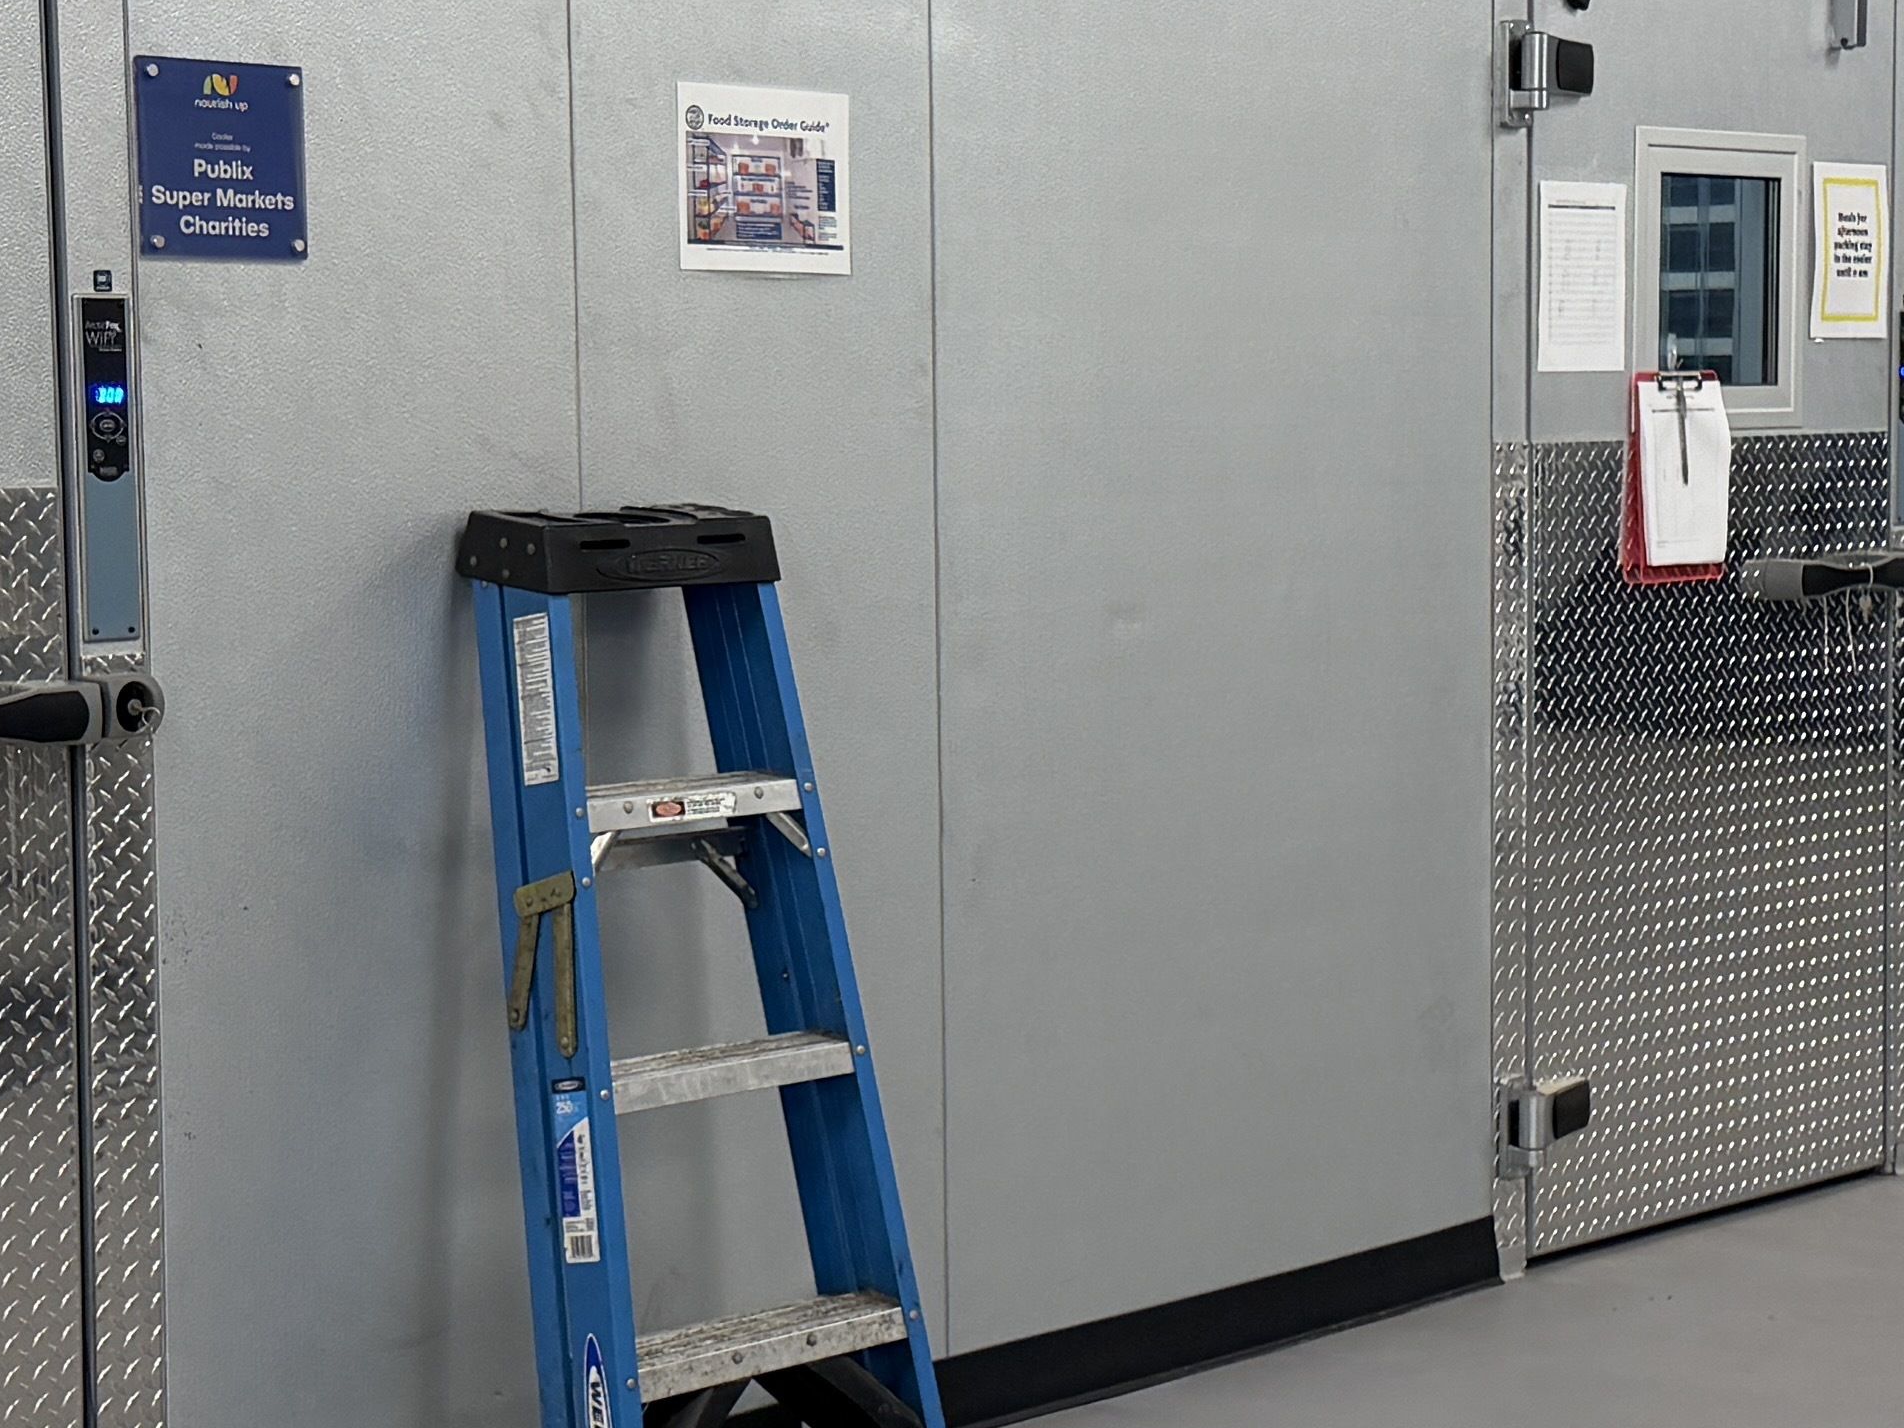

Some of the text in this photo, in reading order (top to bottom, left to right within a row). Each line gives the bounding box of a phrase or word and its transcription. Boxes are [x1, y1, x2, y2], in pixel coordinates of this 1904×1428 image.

[194, 98, 249, 112] nourish up
[707, 113, 732, 127] Food
[733, 115, 769, 132] Storage
[771, 118, 798, 130] Order
[193, 158, 254, 180] Publix
[151, 185, 295, 211] Super Markets
[179, 215, 270, 238] Charities
